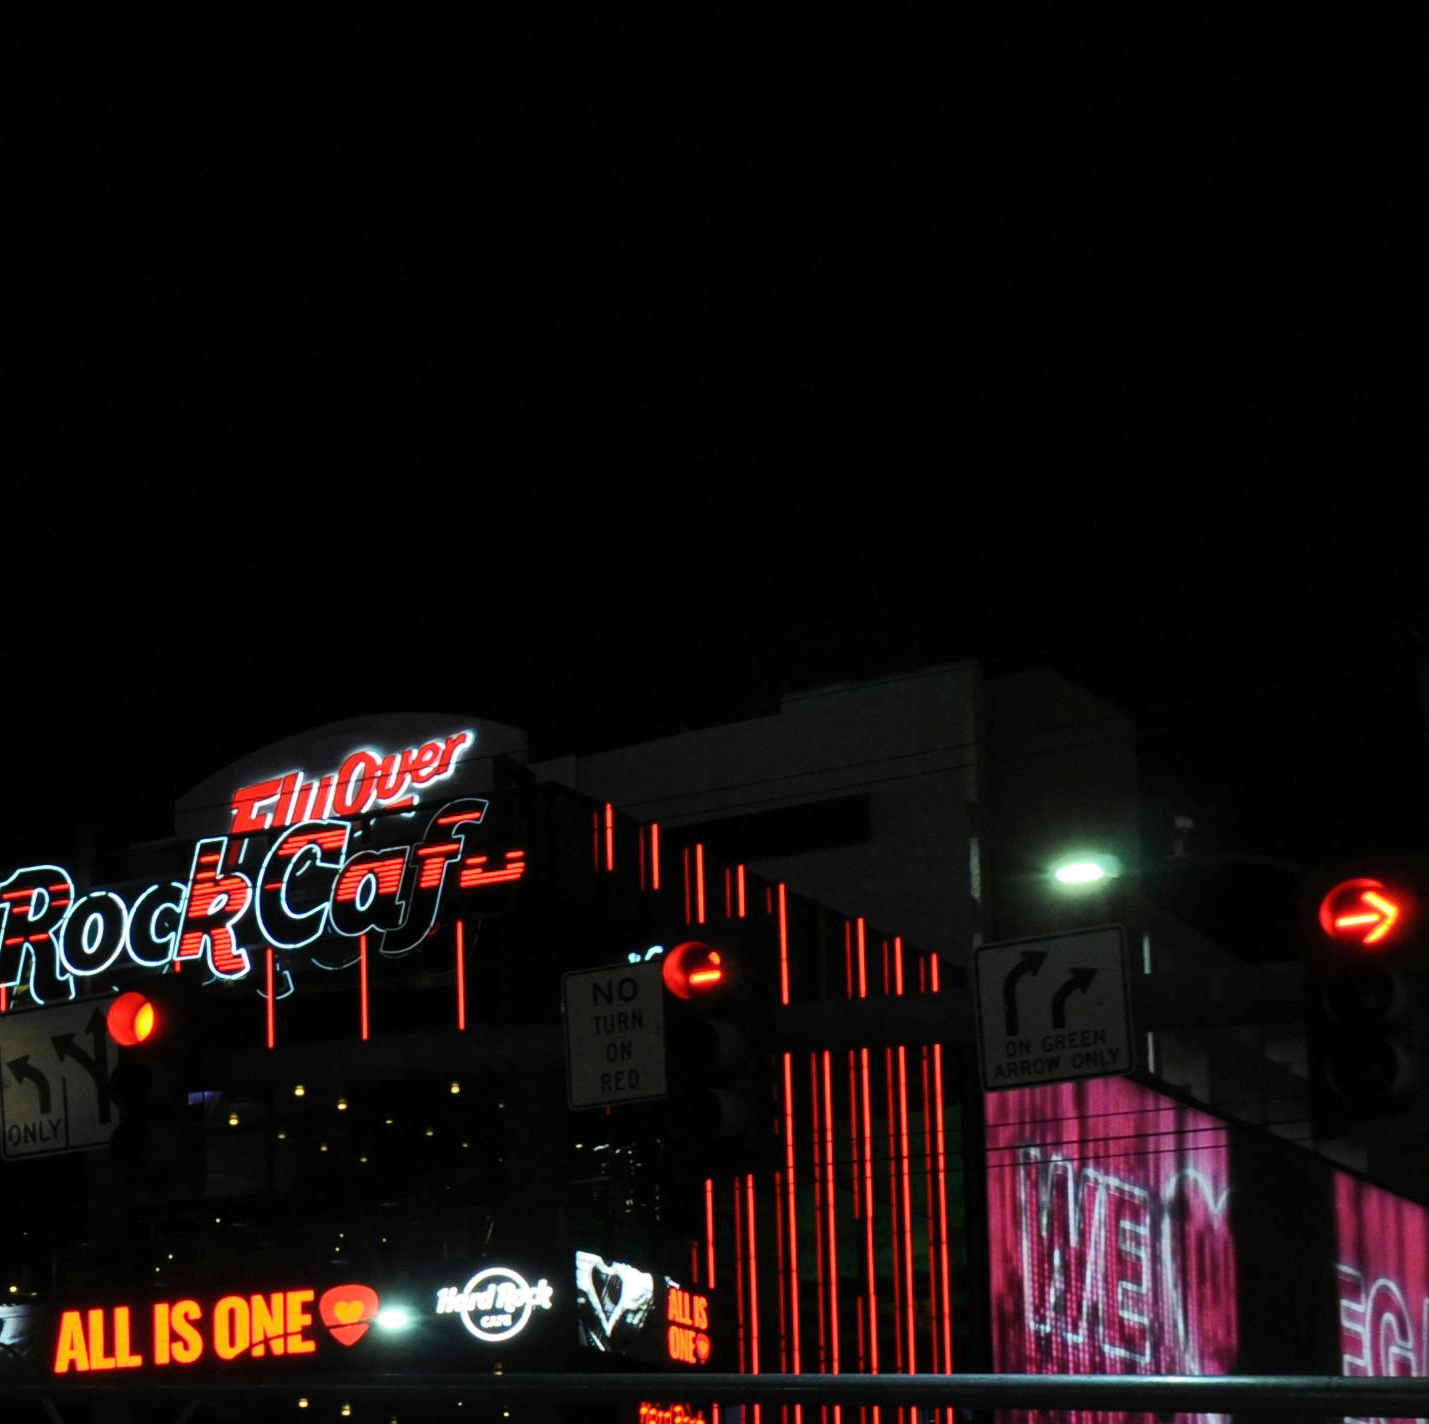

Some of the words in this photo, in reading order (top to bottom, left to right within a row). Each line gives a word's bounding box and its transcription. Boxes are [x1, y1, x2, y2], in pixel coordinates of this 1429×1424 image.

[593, 978, 638, 1006] NO
[593, 1010, 643, 1035] TURN
[606, 1042, 632, 1062] ON
[1005, 1039, 1031, 1057] ON
[1042, 1029, 1106, 1052] GREEN
[995, 1056, 1060, 1081] ARROW
[1072, 1047, 1120, 1069] ONLY
[601, 1070, 639, 1093] RED
[7, 1117, 63, 1146] ONLY
[436, 1284, 495, 1314] Hard
[495, 1279, 553, 1313] Rock
[668, 1287, 692, 1325] ALL
[692, 1293, 708, 1330] IS
[54, 1305, 143, 1374] ALL
[154, 1298, 203, 1365] IS
[213, 1290, 316, 1360] ONE
[480, 1315, 512, 1329] CAFE
[668, 1325, 697, 1365] ONE
